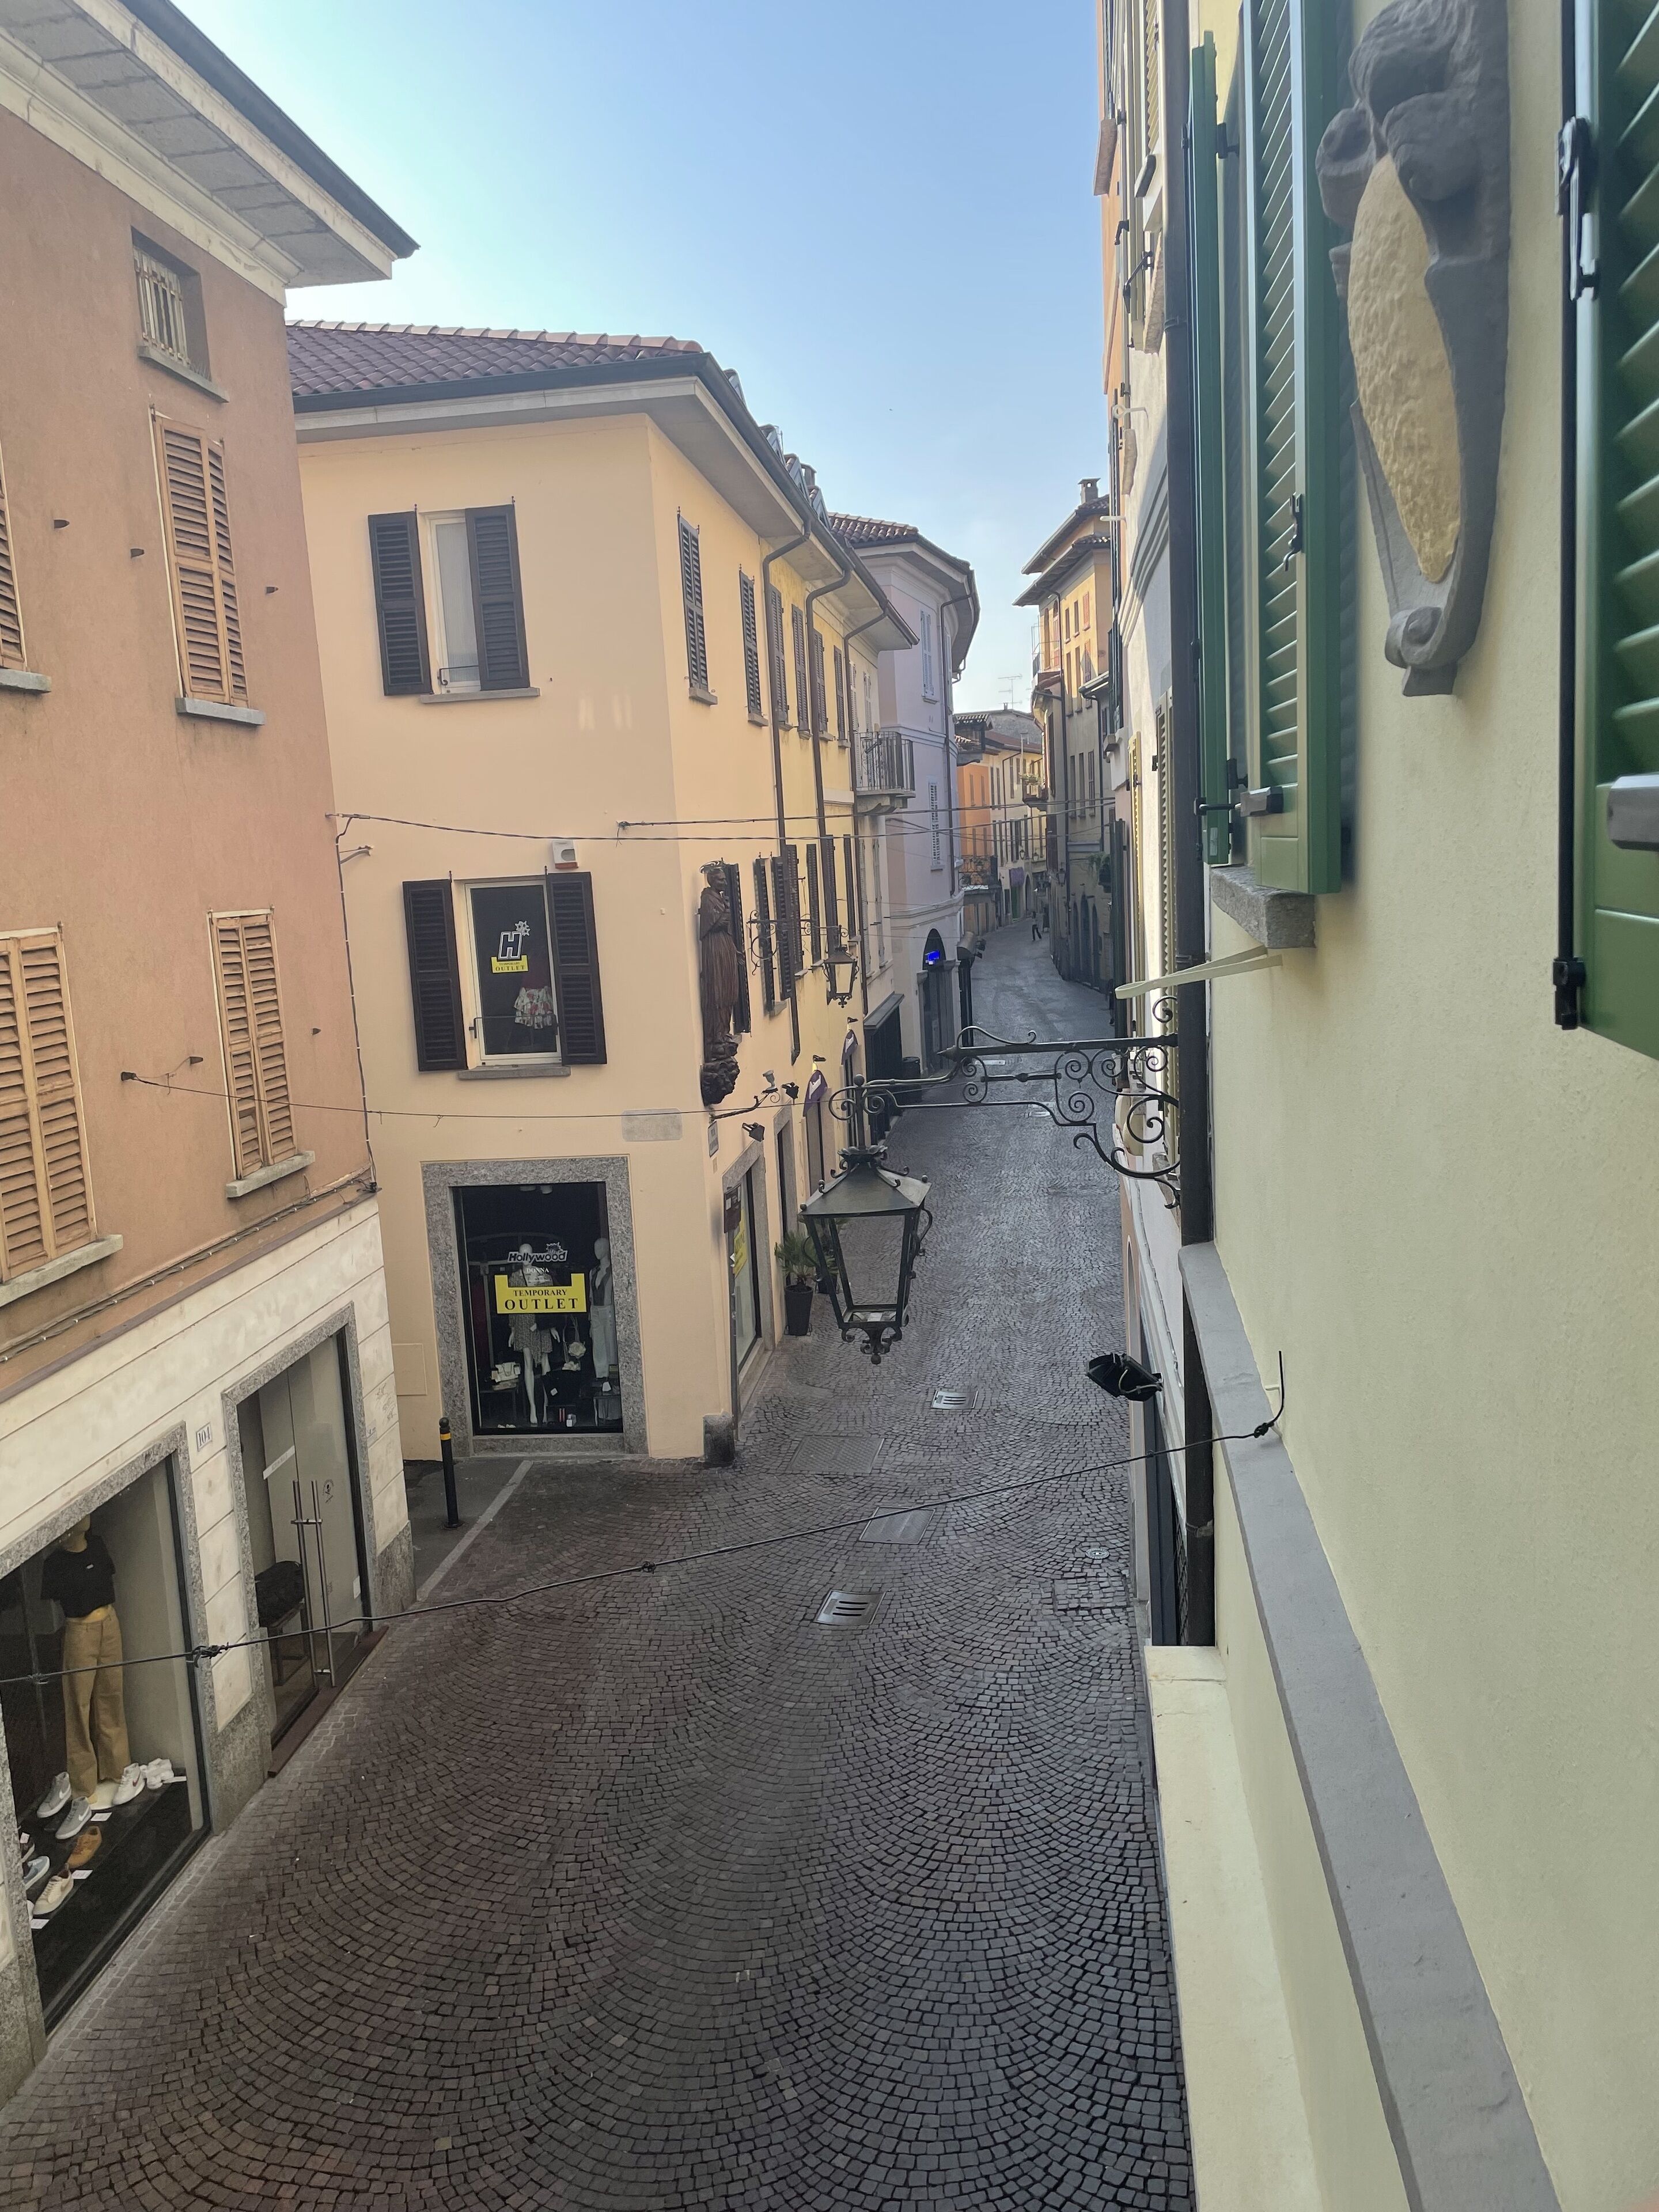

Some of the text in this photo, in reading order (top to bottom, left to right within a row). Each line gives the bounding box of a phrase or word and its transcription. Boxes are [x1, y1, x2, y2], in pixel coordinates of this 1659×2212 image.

[498, 931, 522, 960] H
[508, 1251, 567, 1263] Hollywood
[505, 1298, 578, 1310] OUTLET
[198, 1426, 210, 1446] 101
